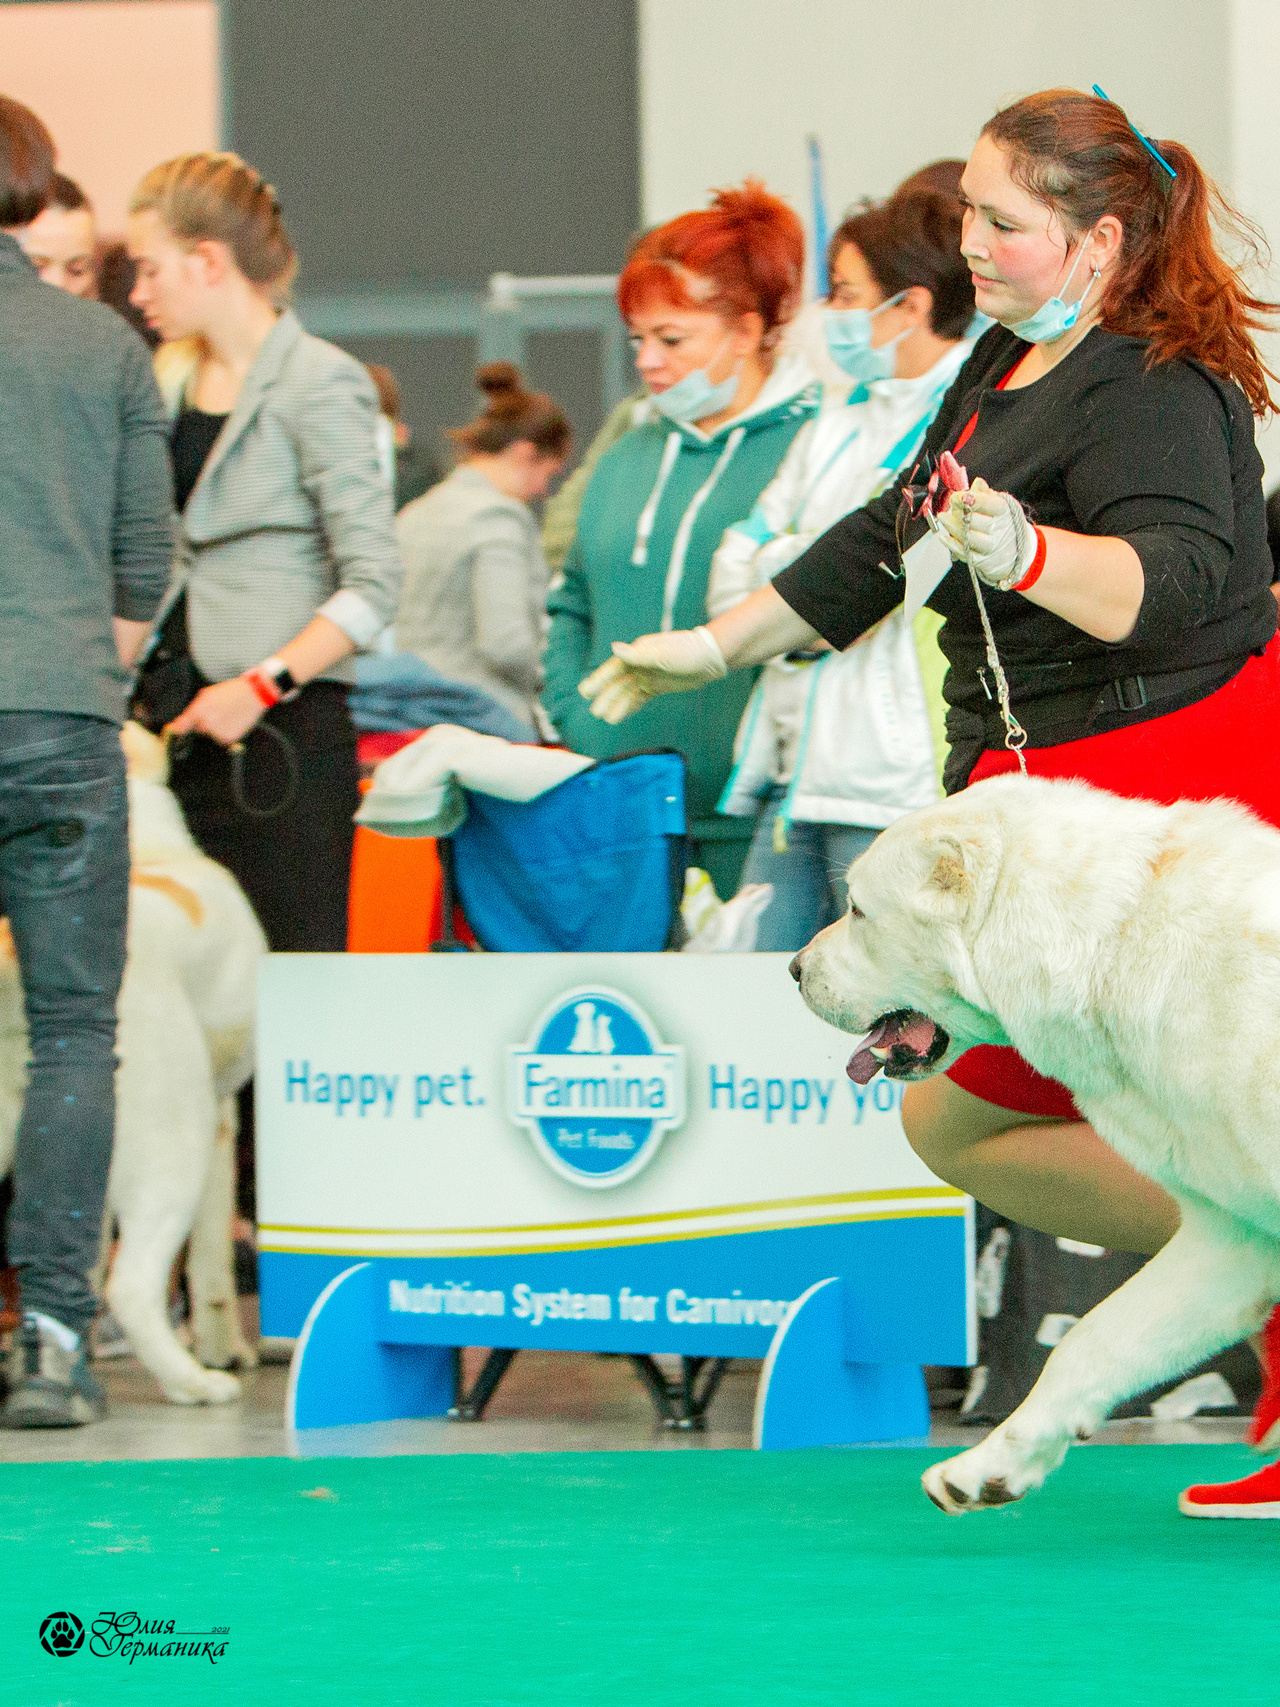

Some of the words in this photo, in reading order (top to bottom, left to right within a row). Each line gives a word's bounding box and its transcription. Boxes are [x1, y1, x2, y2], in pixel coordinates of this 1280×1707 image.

[285, 1059, 400, 1118] Happy
[413, 1064, 486, 1119] pet.
[524, 1062, 667, 1109] Farmina
[708, 1063, 836, 1125] Happy
[388, 1279, 506, 1316] Nutrition
[512, 1283, 612, 1327] System
[618, 1287, 660, 1322] for
[666, 1288, 796, 1327] Carnivor
